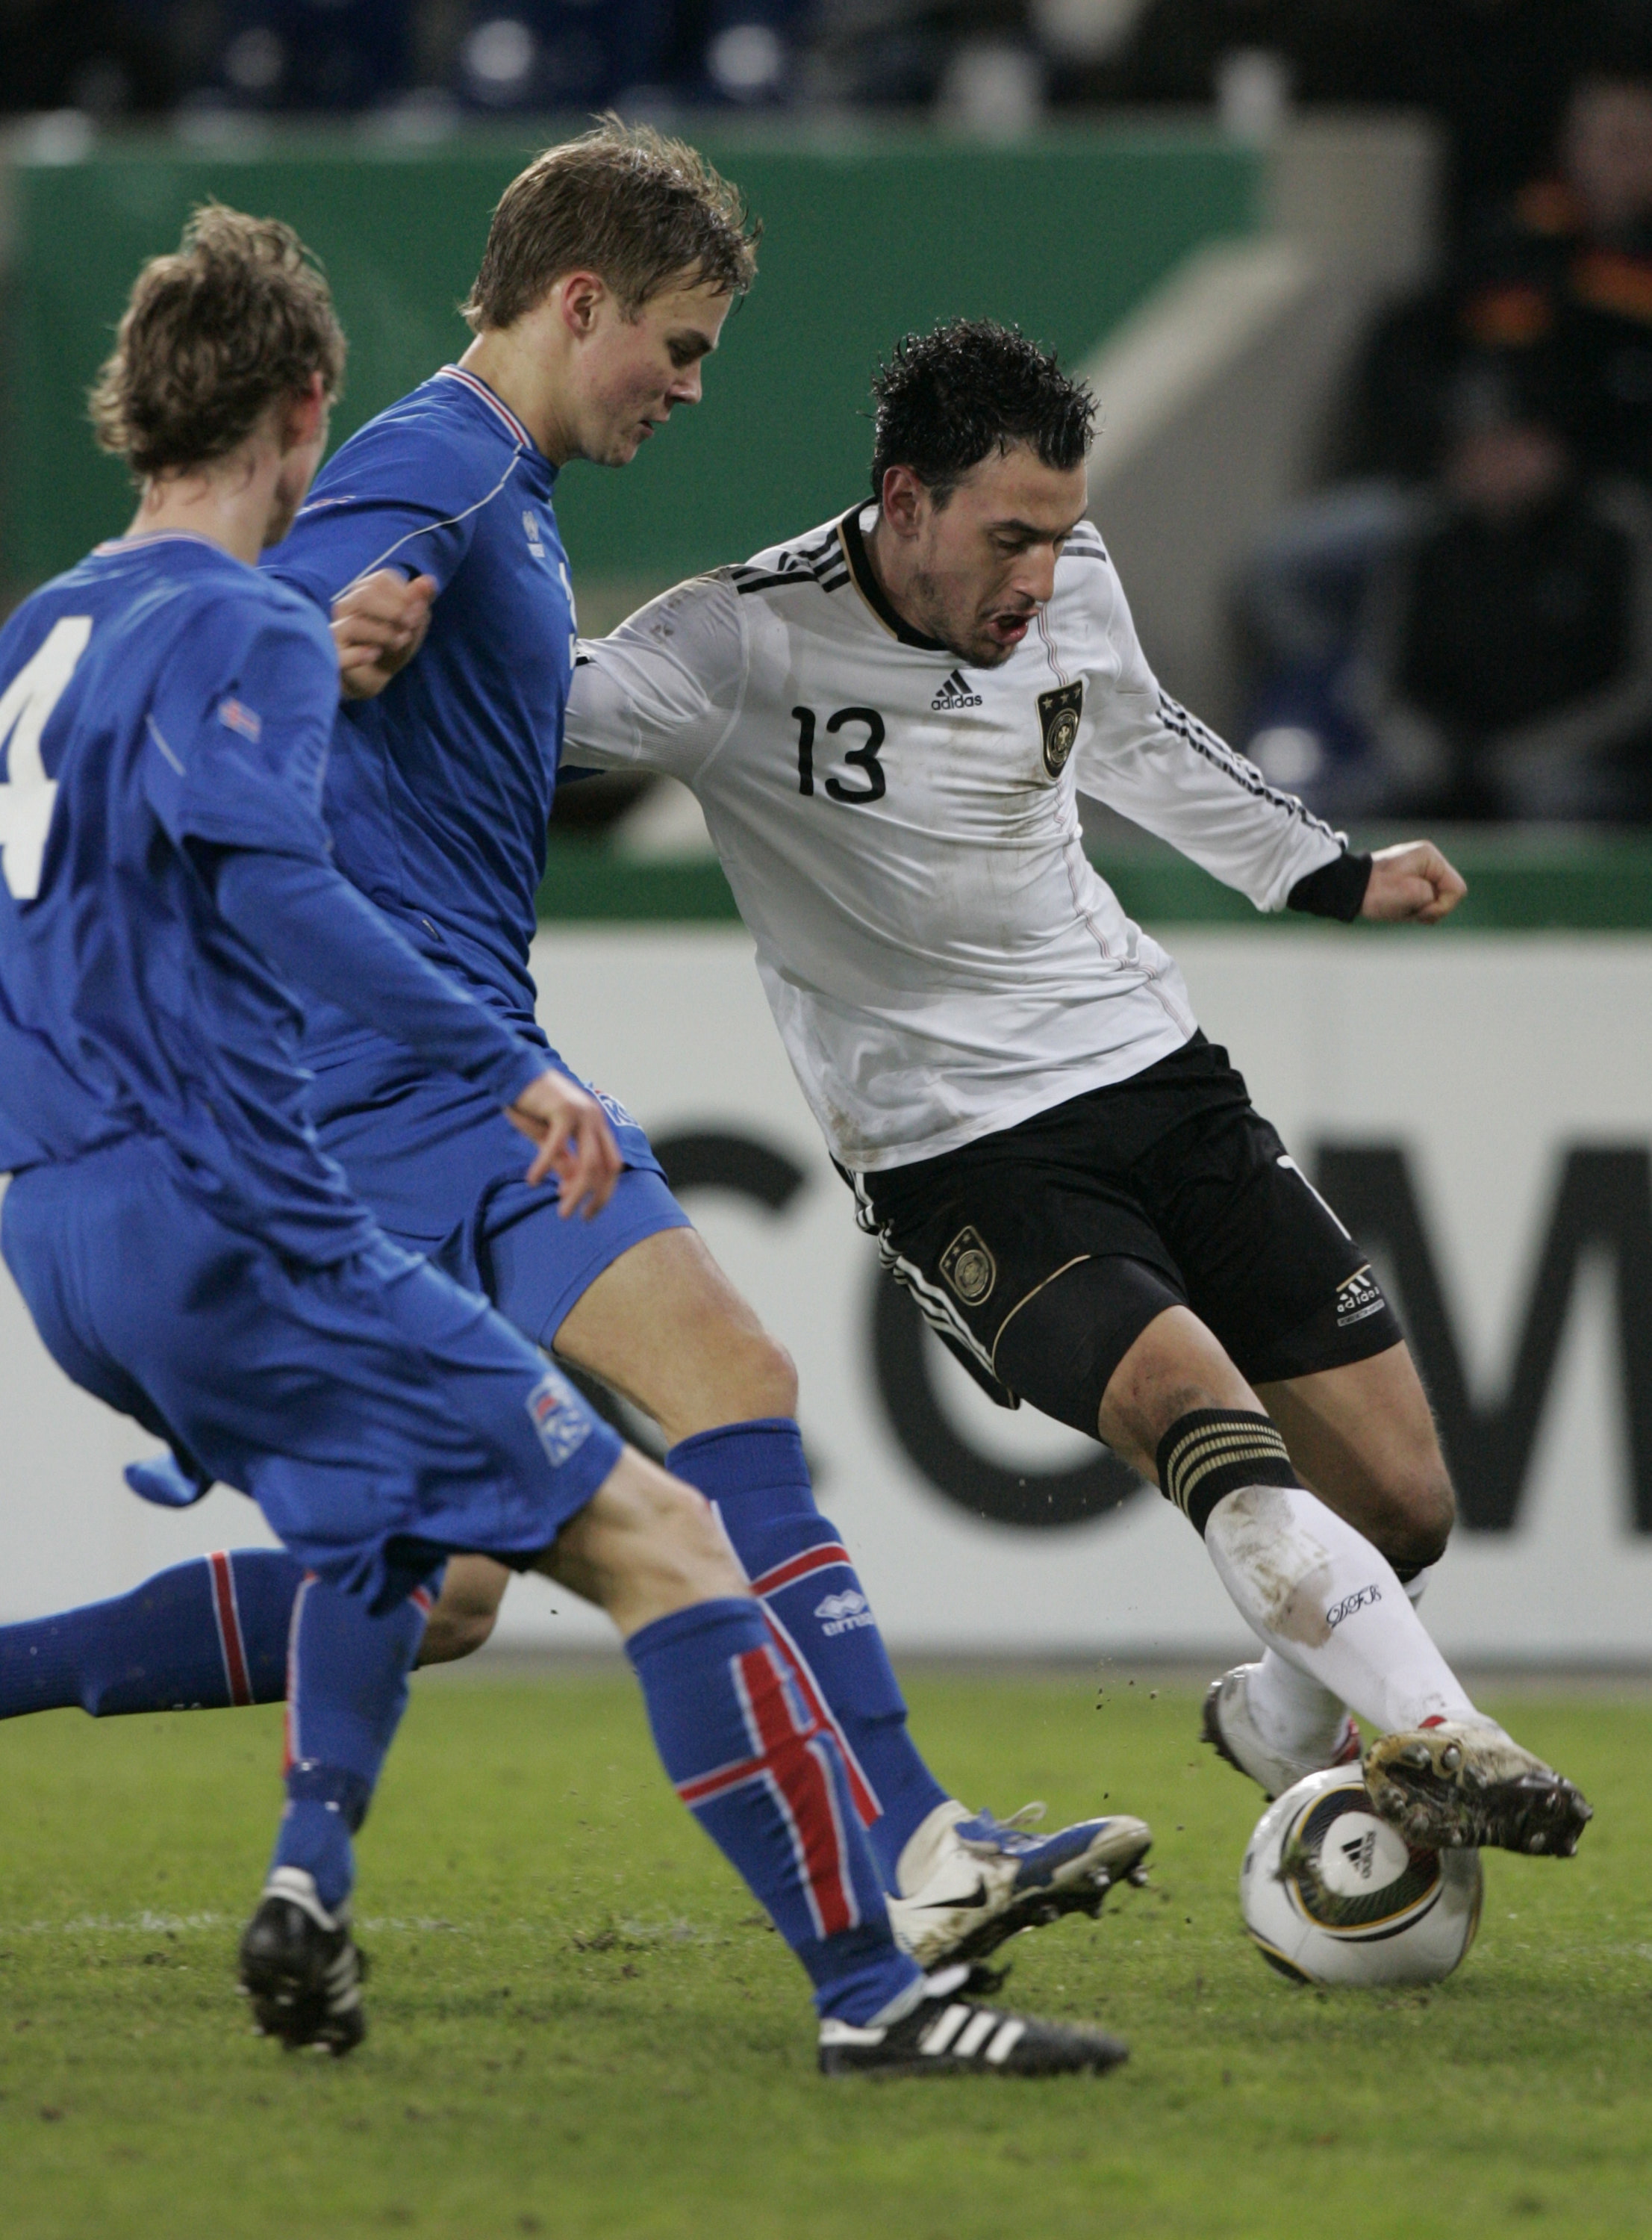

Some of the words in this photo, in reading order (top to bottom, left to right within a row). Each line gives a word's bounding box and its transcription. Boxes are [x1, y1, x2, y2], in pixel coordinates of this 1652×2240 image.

[931, 693, 983, 711] adidas
[0, 615, 94, 900] 4
[791, 706, 886, 804] 13
